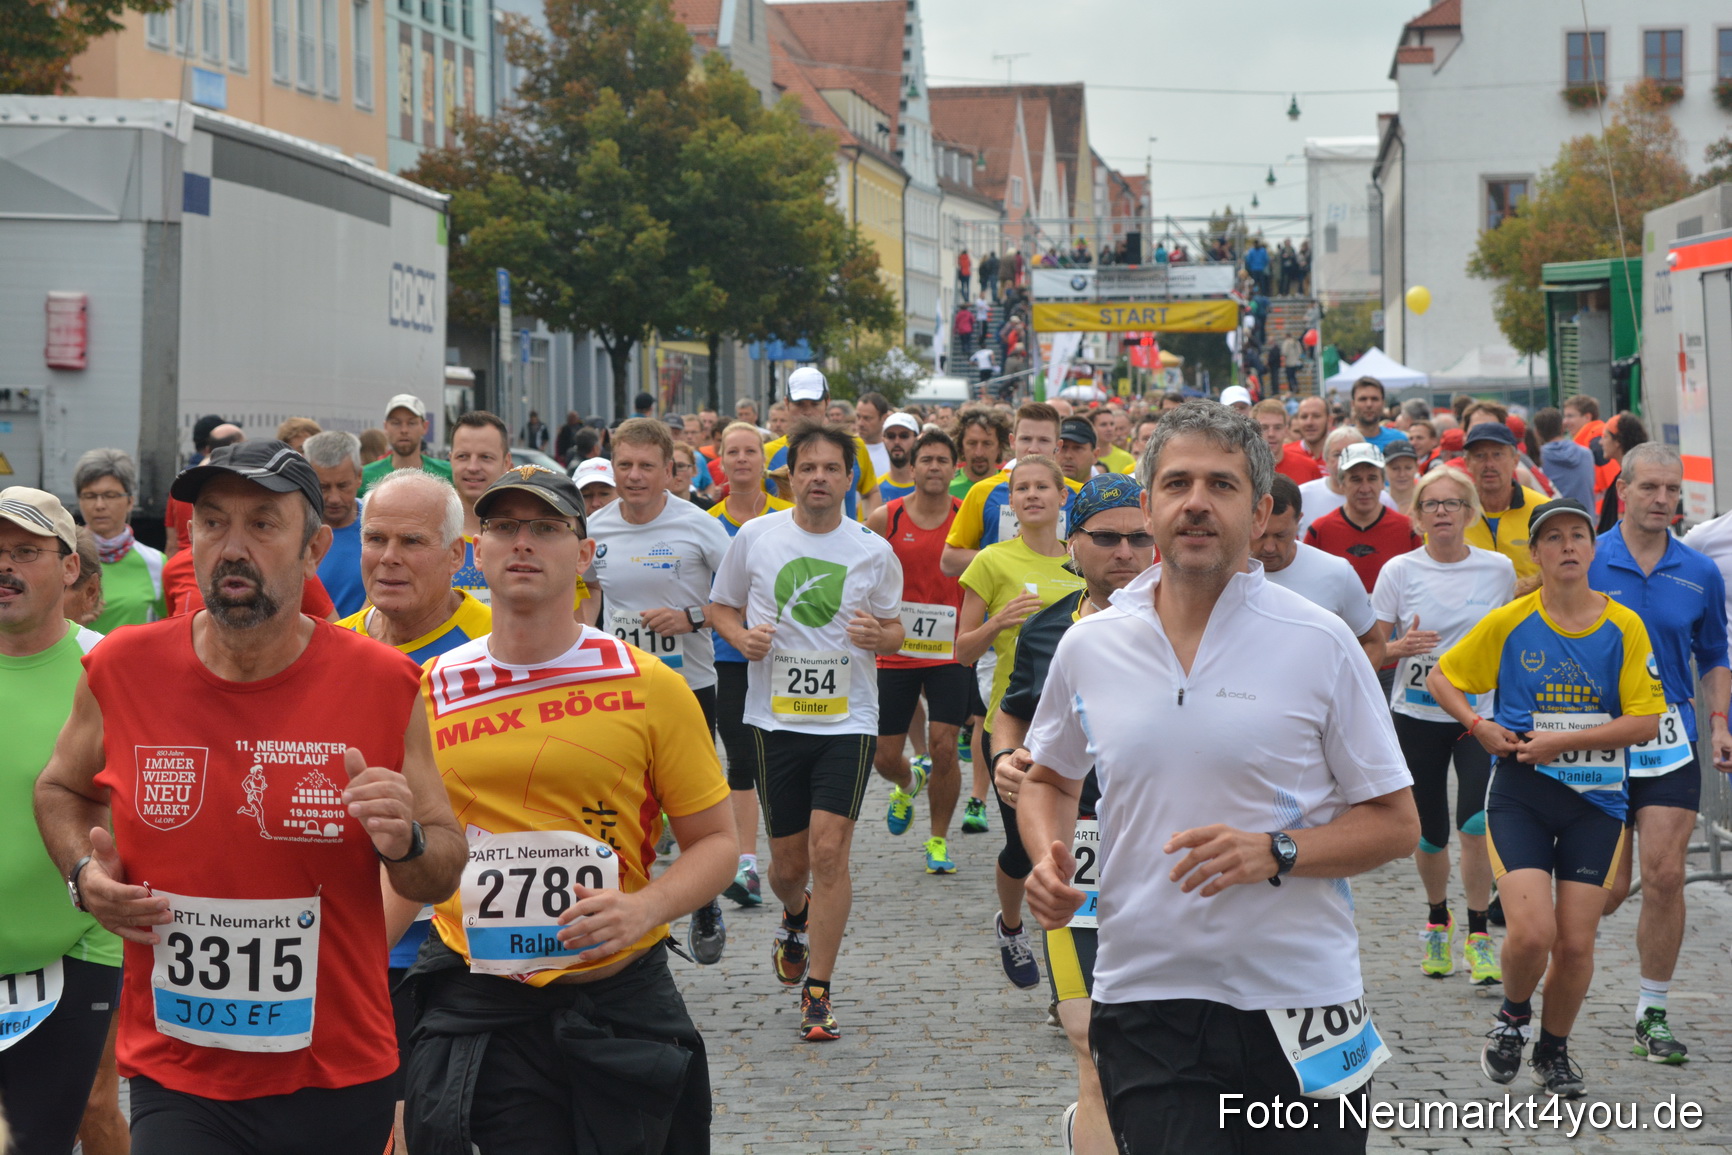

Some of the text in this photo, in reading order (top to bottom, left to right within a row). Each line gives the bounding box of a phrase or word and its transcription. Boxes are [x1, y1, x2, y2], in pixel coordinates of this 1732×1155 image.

[389, 262, 436, 333] BOCK
[1100, 308, 1170, 325] START
[912, 617, 937, 638] 47
[903, 640, 943, 651] Ferdinand
[774, 655, 799, 664] PARTL
[787, 667, 837, 695] 254
[793, 700, 828, 713] Günter
[436, 690, 645, 751] MAX BÖGL
[1536, 721, 1566, 730] PARTL
[235, 740, 347, 754] 11. NEUMARKTER
[144, 757, 195, 770] IMMER
[253, 752, 329, 766] STADTLAUF
[1640, 754, 1662, 766] Uwe
[142, 770, 197, 783] WIEDER
[1558, 770, 1602, 783] Daniela
[143, 784, 192, 802] NEU
[142, 804, 190, 816] MARKT
[289, 808, 345, 819] 19.09.2010
[273, 835, 344, 844] www.stadtlauf-neumarkt.de
[468, 844, 590, 862] PARTL Neumarkt
[210, 913, 291, 929] Neumarkt
[167, 931, 303, 993] 3315
[175, 998, 283, 1026] JOSEF
